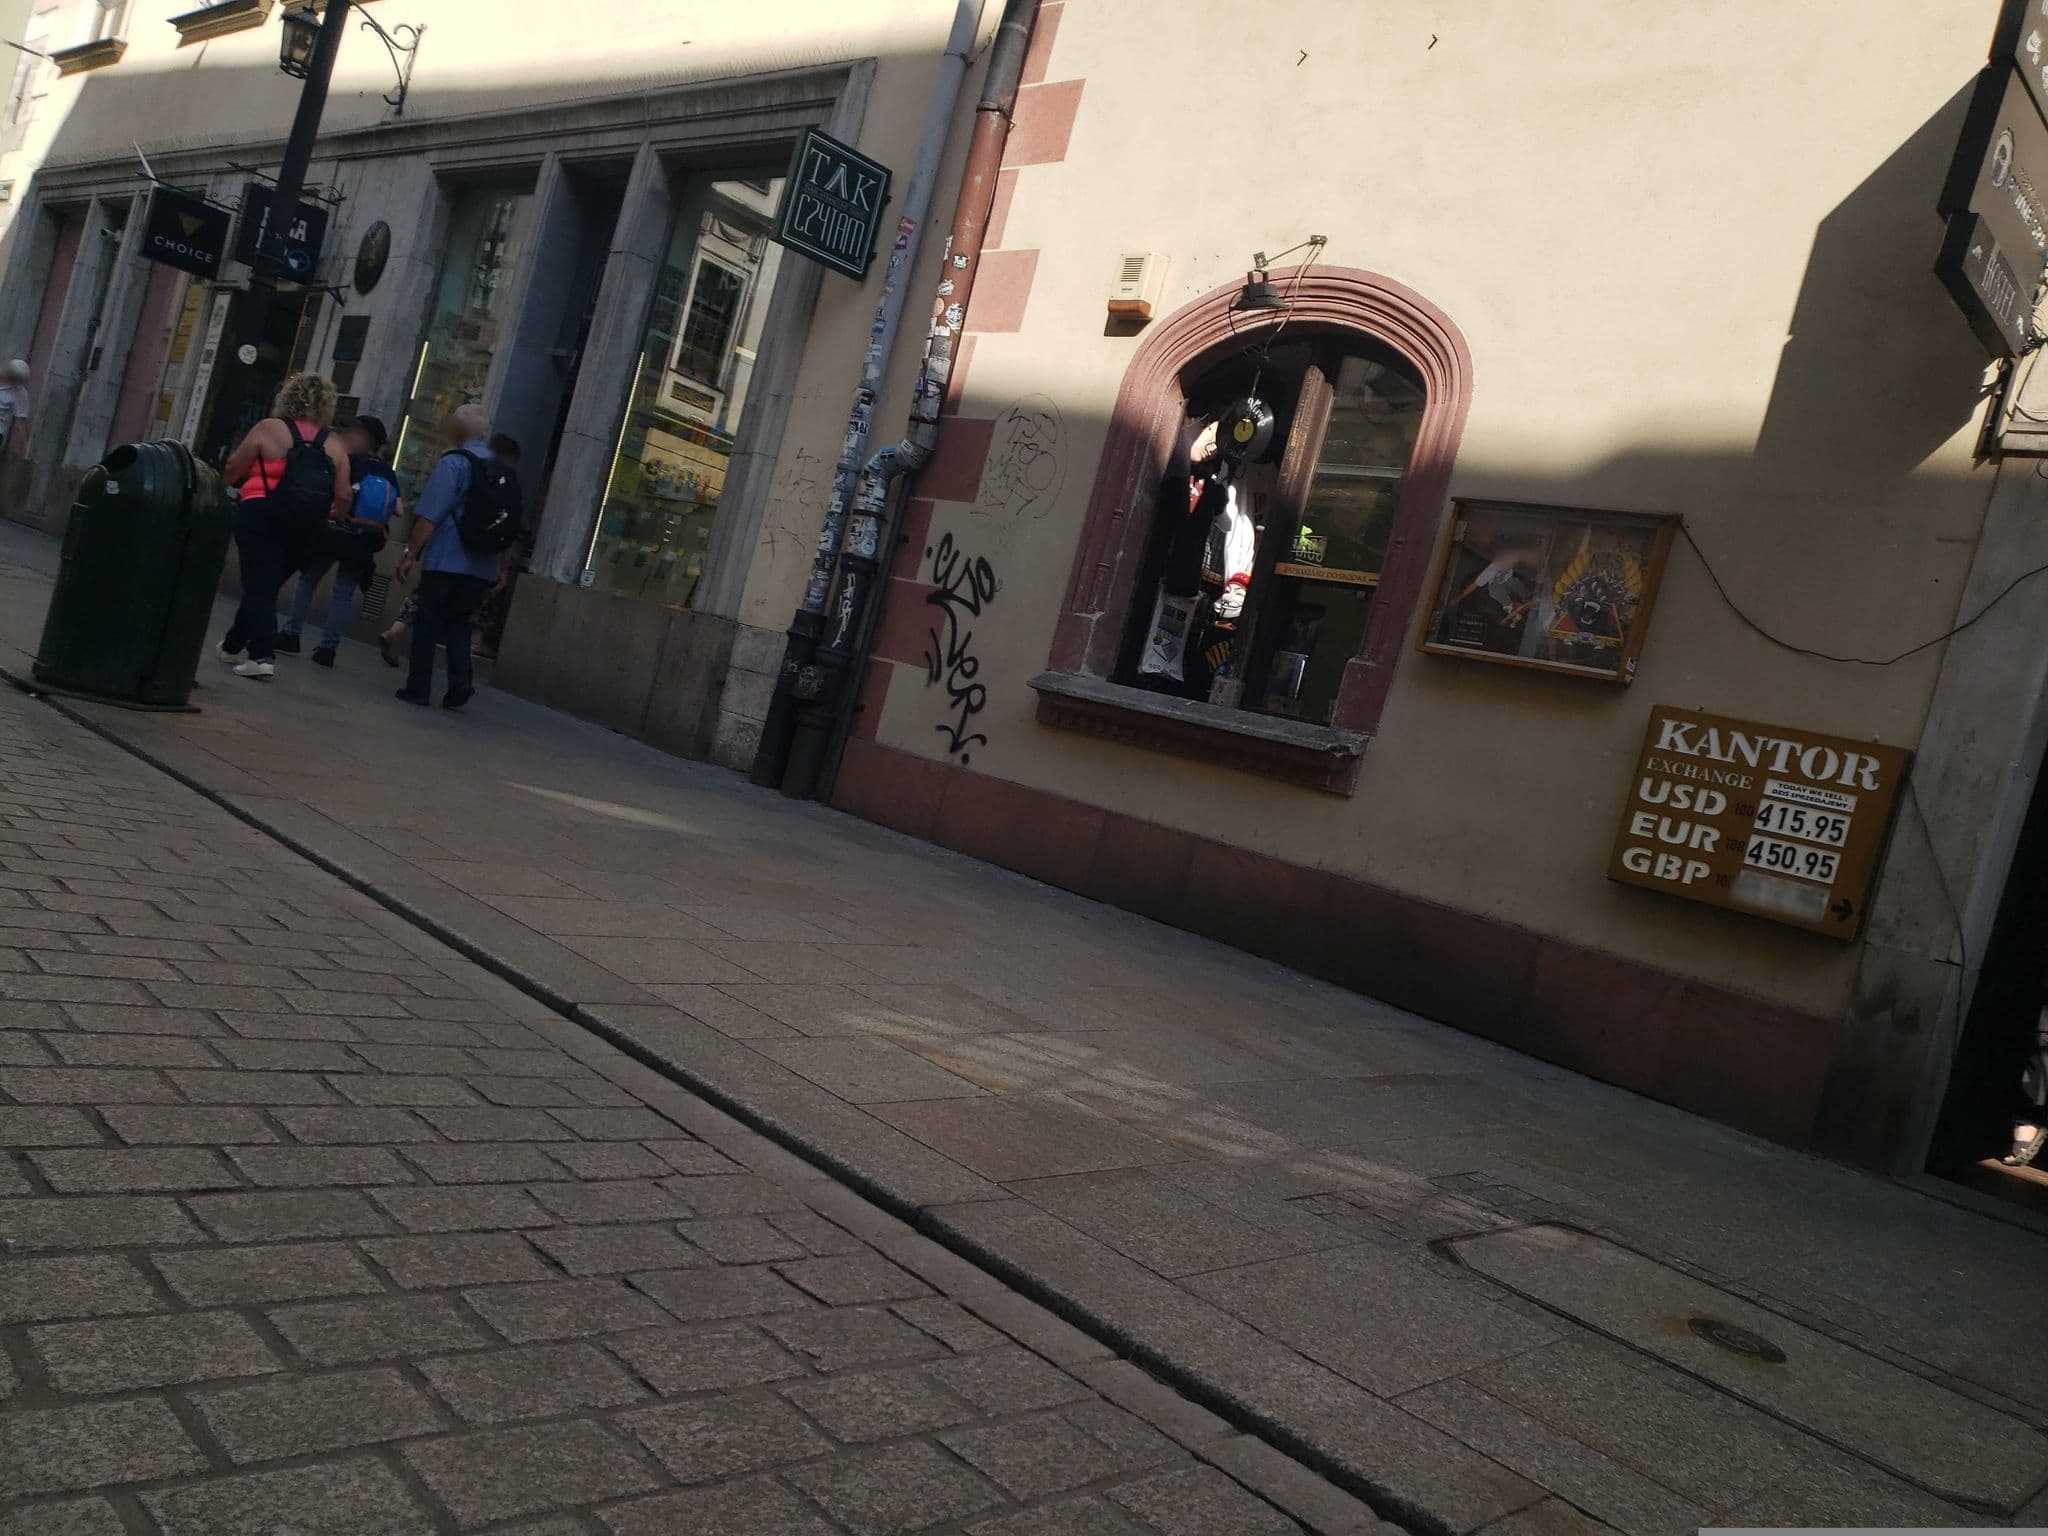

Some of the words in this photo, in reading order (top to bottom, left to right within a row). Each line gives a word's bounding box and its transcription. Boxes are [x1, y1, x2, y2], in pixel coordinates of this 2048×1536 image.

[809, 147, 877, 212] TAK
[794, 193, 866, 257] CZYTAM
[154, 235, 215, 264] CHOICE
[1646, 756, 1754, 790] EXCHANGE
[1654, 718, 1881, 791] KANTOR
[1639, 777, 1727, 816] USD
[1757, 803, 1846, 842] 415,95
[1779, 782, 1808, 794] TODAY
[1809, 788, 1823, 797] WE
[1629, 810, 1721, 853] EUR
[1621, 846, 1712, 885] GBP
